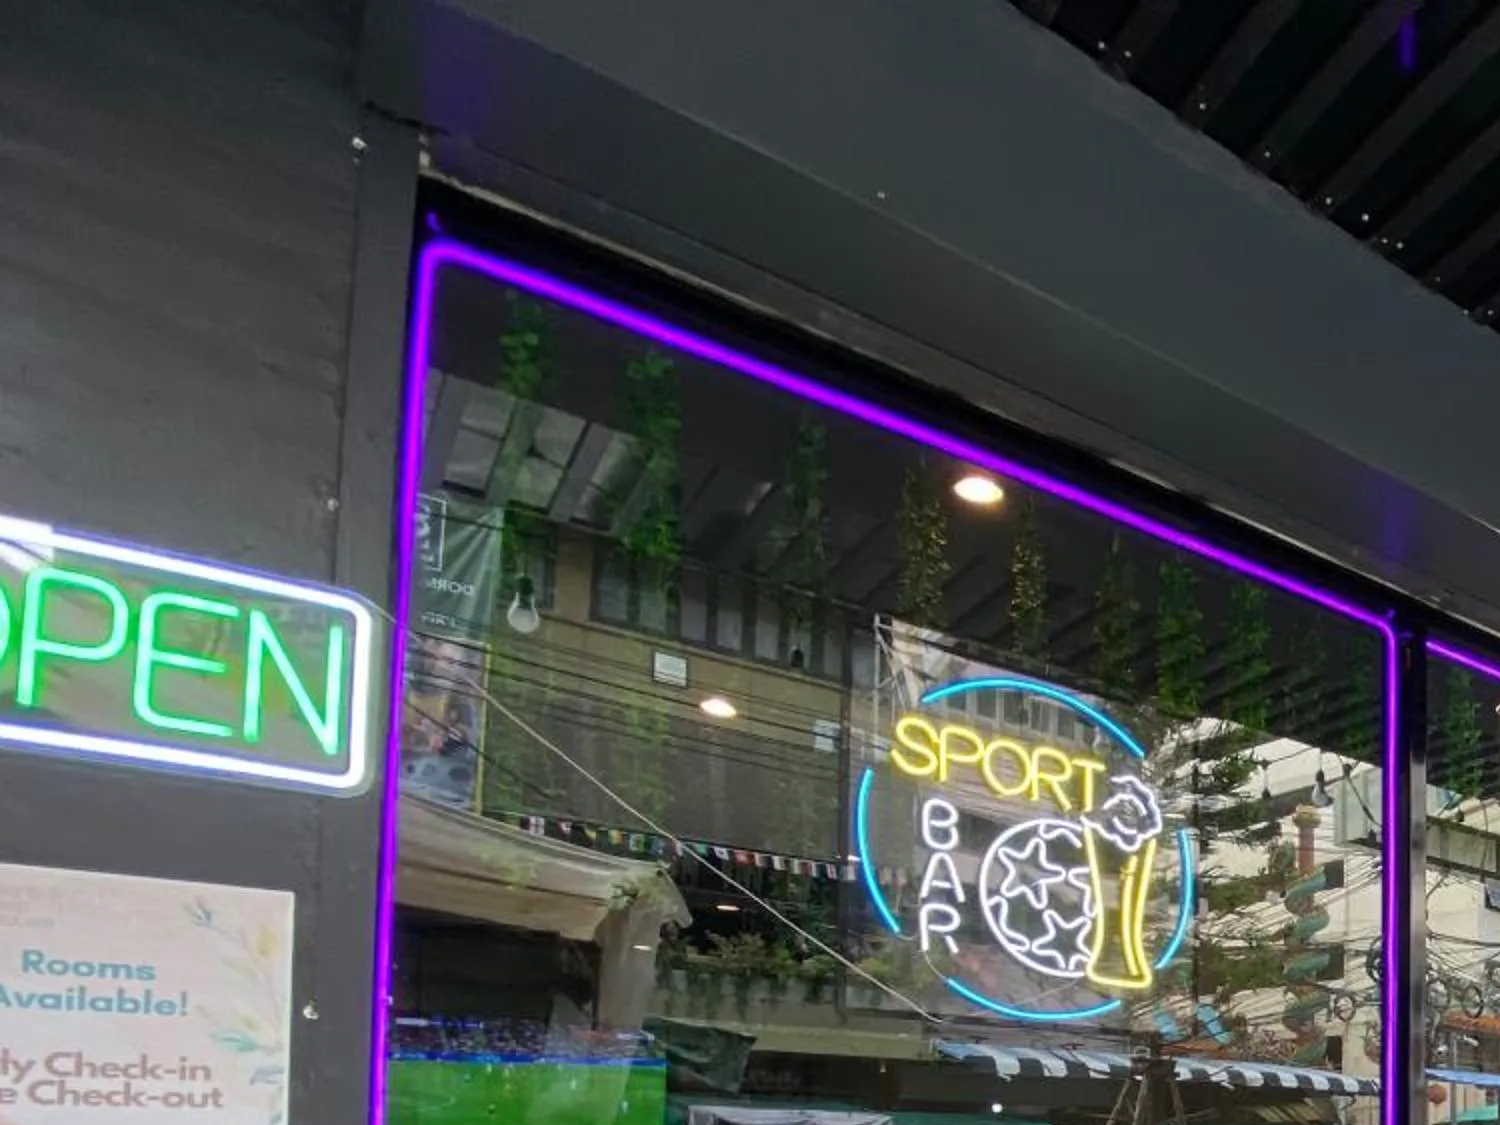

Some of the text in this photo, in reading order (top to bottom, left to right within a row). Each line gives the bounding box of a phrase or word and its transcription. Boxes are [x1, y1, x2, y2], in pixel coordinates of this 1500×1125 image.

[0, 565, 343, 755] PEN
[891, 716, 1106, 814] SPORT
[919, 799, 966, 954] BAR
[21, 949, 156, 981] Rooms
[26, 1079, 225, 1109] Check-out
[44, 1050, 212, 1081] Check-in
